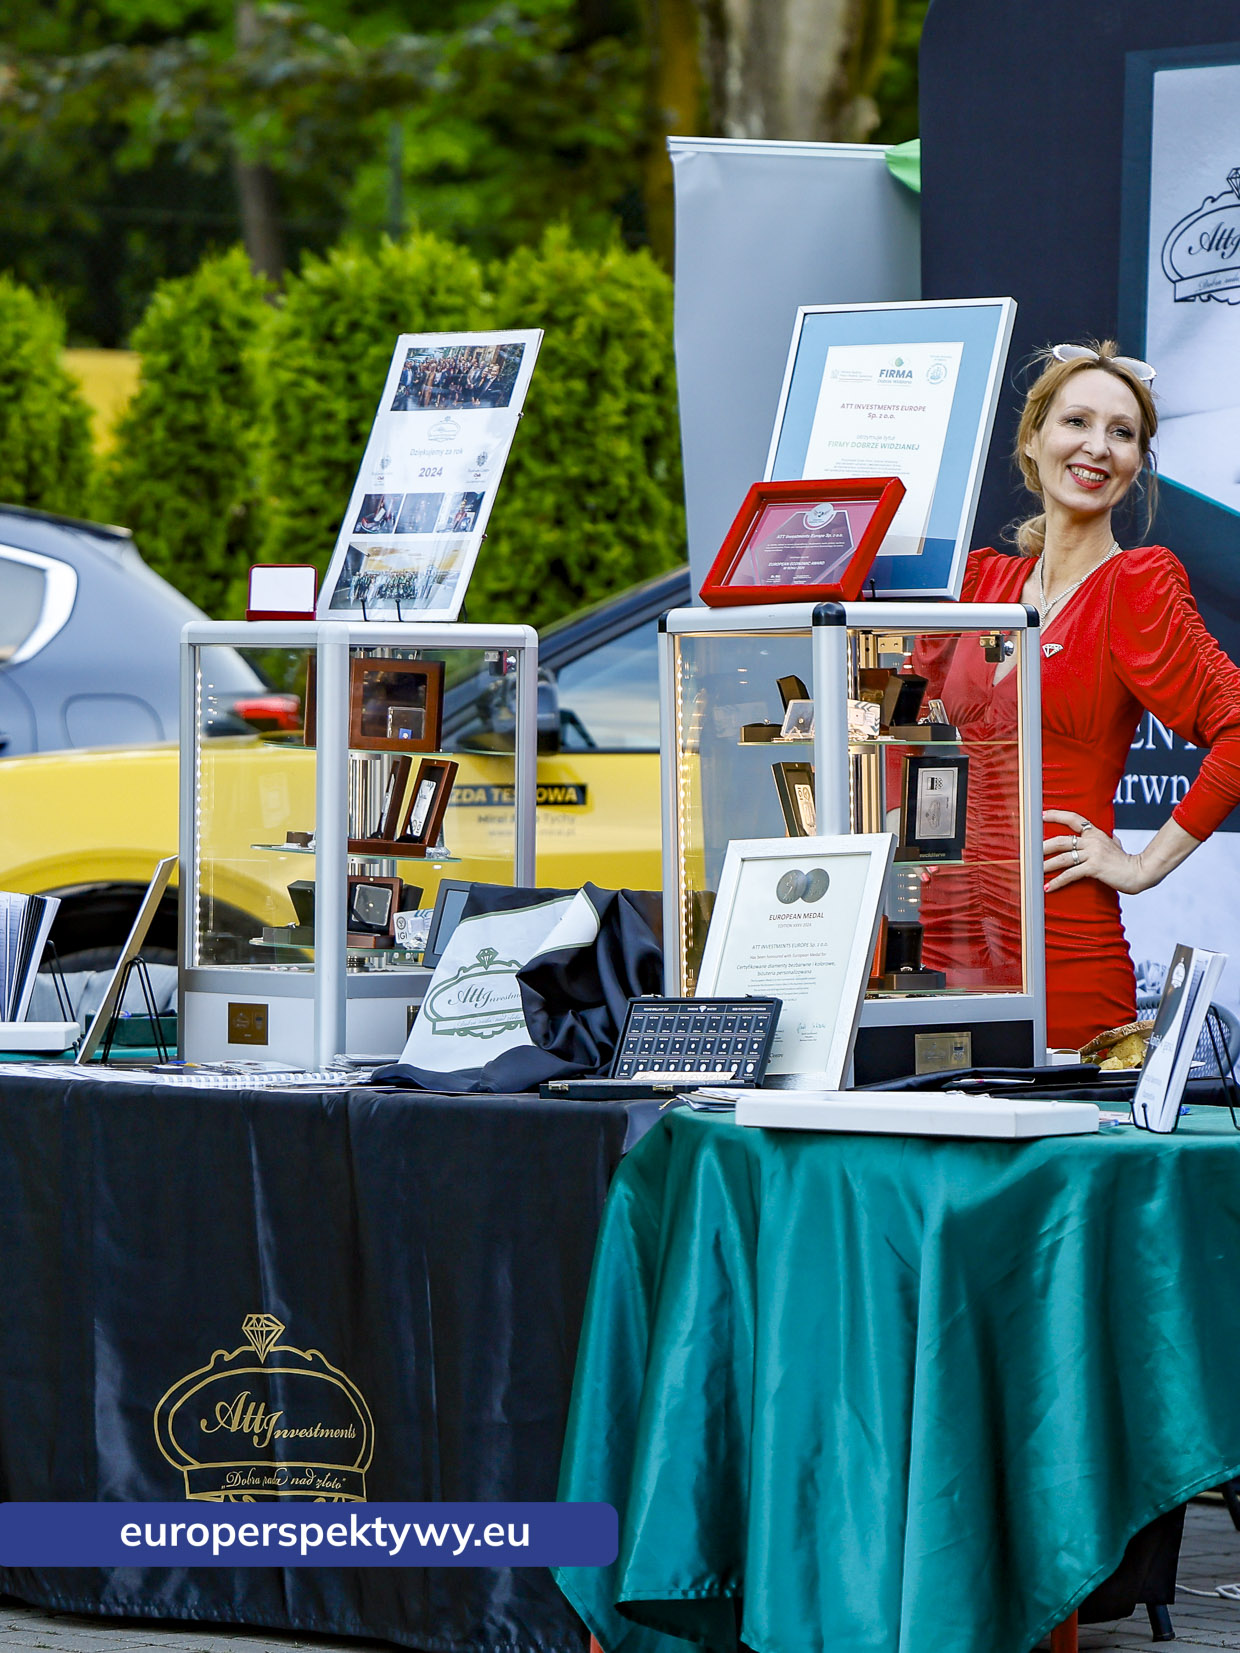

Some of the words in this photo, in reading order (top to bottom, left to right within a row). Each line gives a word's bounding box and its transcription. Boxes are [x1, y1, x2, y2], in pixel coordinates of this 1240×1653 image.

[879, 369, 913, 379] FIRMA
[854, 403, 900, 411] INVESTMENTS
[827, 440, 850, 448] FIRMY
[850, 441, 880, 449] DOBRZE
[880, 442, 920, 450] WIDZIANEJ
[418, 466, 443, 477] 2024
[768, 913, 801, 921] EUROPEAN
[262, 1467, 289, 1487] rada
[290, 1468, 316, 1486] nad
